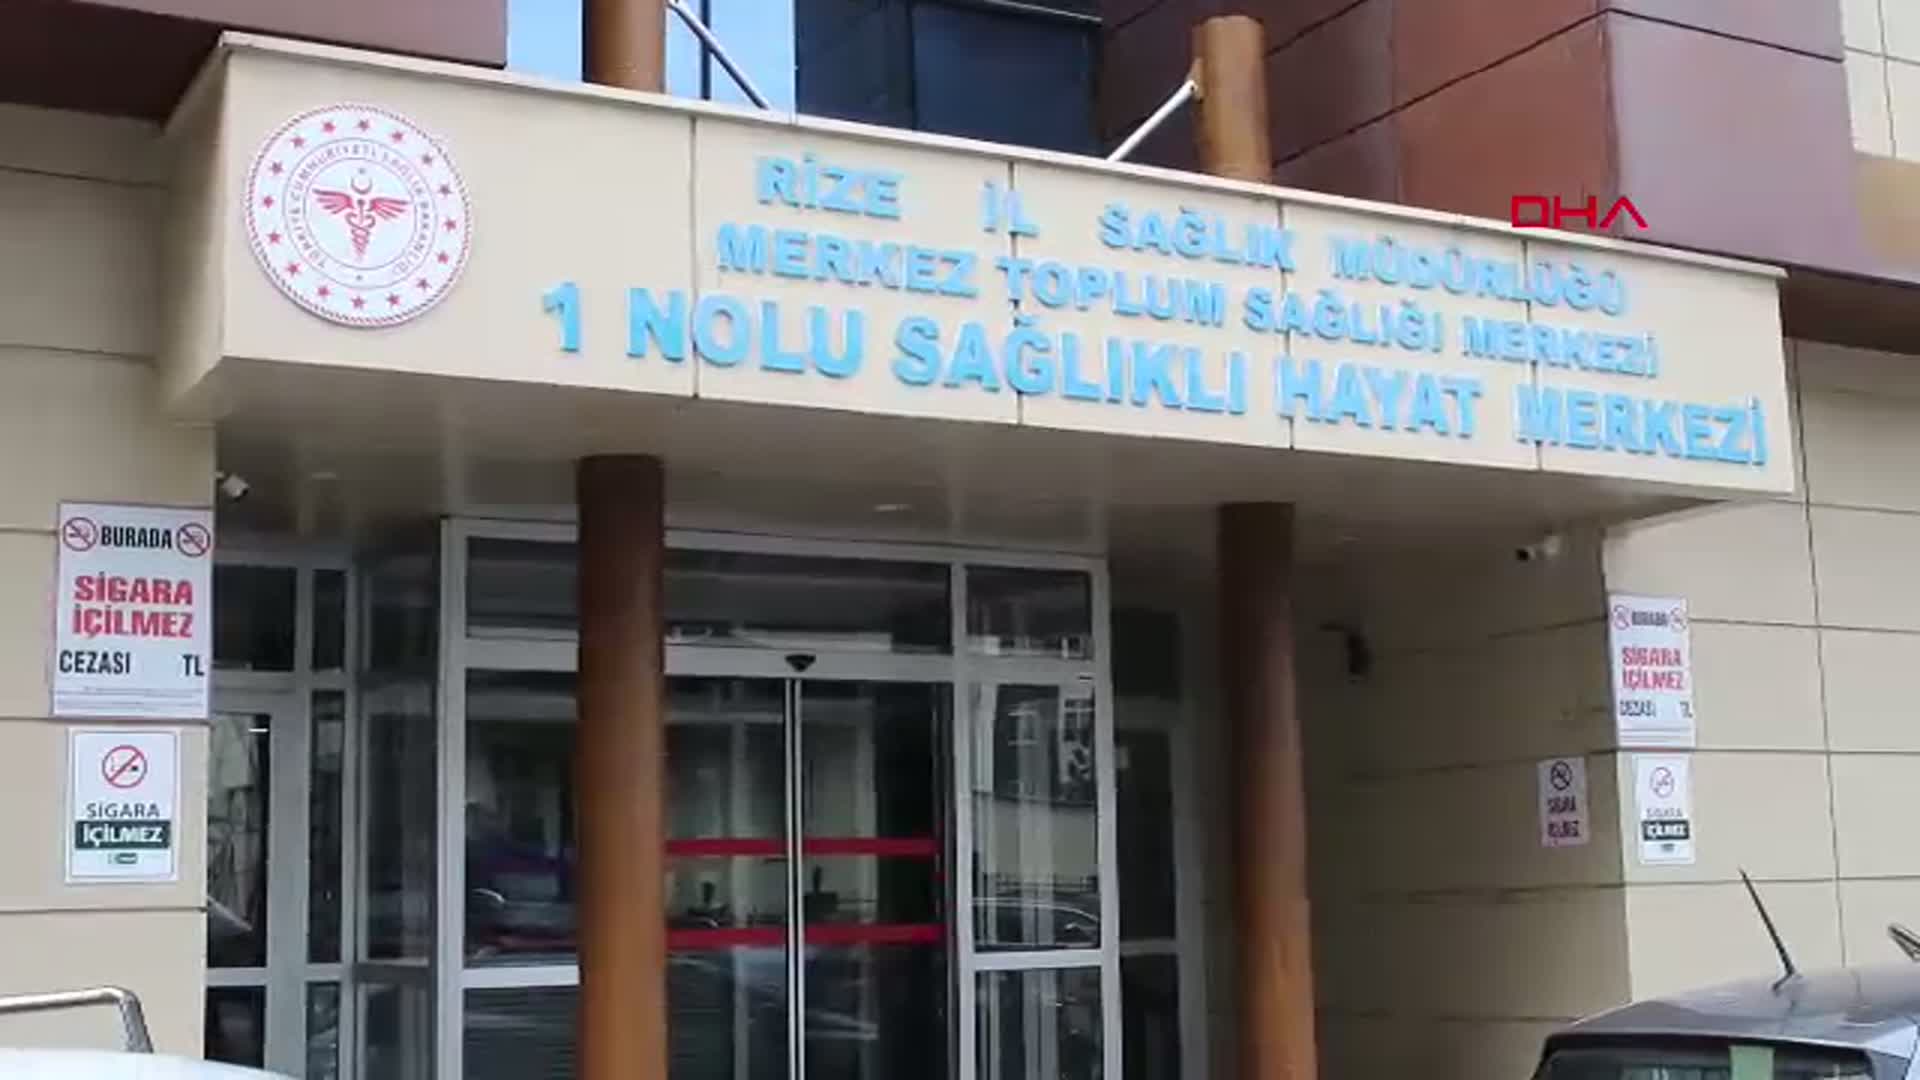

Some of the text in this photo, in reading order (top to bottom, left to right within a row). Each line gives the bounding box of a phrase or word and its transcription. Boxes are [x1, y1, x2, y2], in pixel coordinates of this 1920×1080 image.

[756, 152, 1628, 316] RİZE İL SAĞLIK MÜDÜRLÜĞÜ
[717, 222, 1659, 379] MERKEZ TOPLUM SAĞLIĞI MERKEZİ
[543, 281, 1769, 468] 1 NOLU SAĞLIKLI HAYAT MERKEZİ
[101, 526, 173, 550] BURADA
[73, 572, 194, 606] SİGARA
[71, 602, 194, 639] İÇİLMEZ
[58, 650, 205, 677] CEZASI TL
[86, 800, 161, 819] SİGARA
[82, 823, 163, 847] İÇİLMEZ
